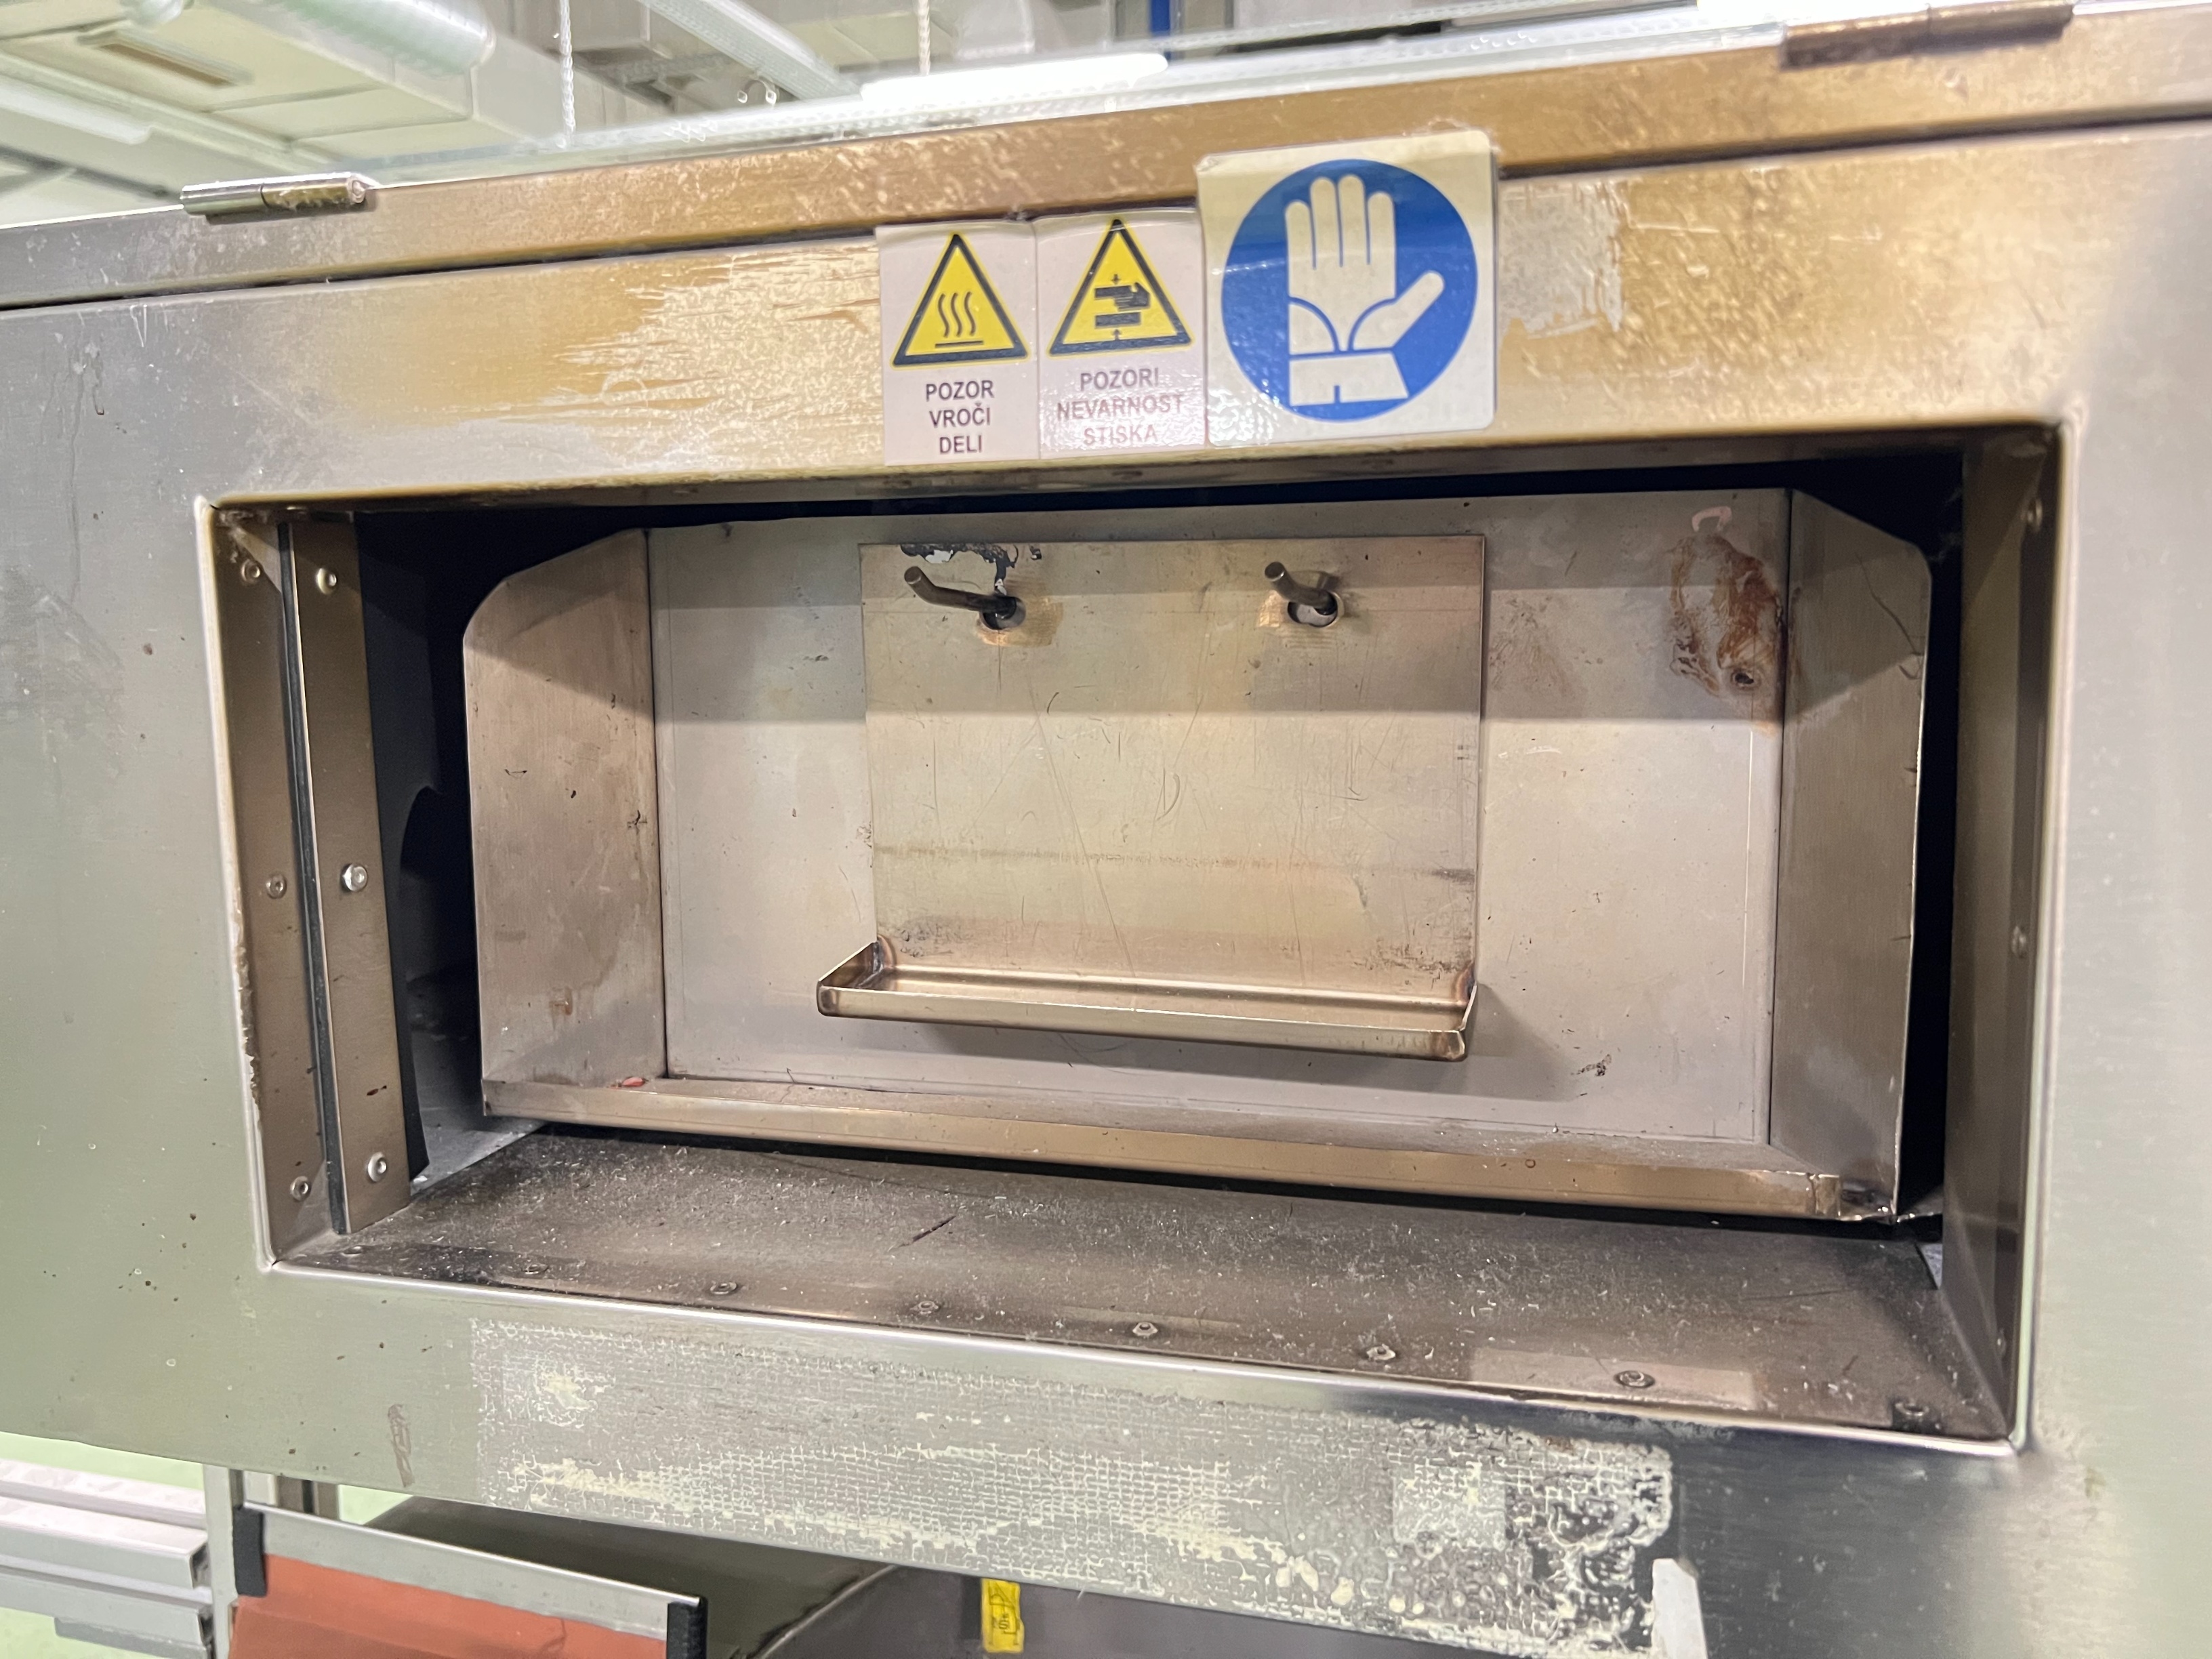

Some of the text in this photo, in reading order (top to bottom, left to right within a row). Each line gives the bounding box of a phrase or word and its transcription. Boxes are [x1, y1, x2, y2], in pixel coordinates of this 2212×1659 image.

[926, 380, 994, 402] POZOR
[929, 403, 991, 428] VROČI
[1057, 394, 1183, 421] NEVARNOST
[939, 435, 982, 454] DELI
[1084, 424, 1158, 446] STISKA
